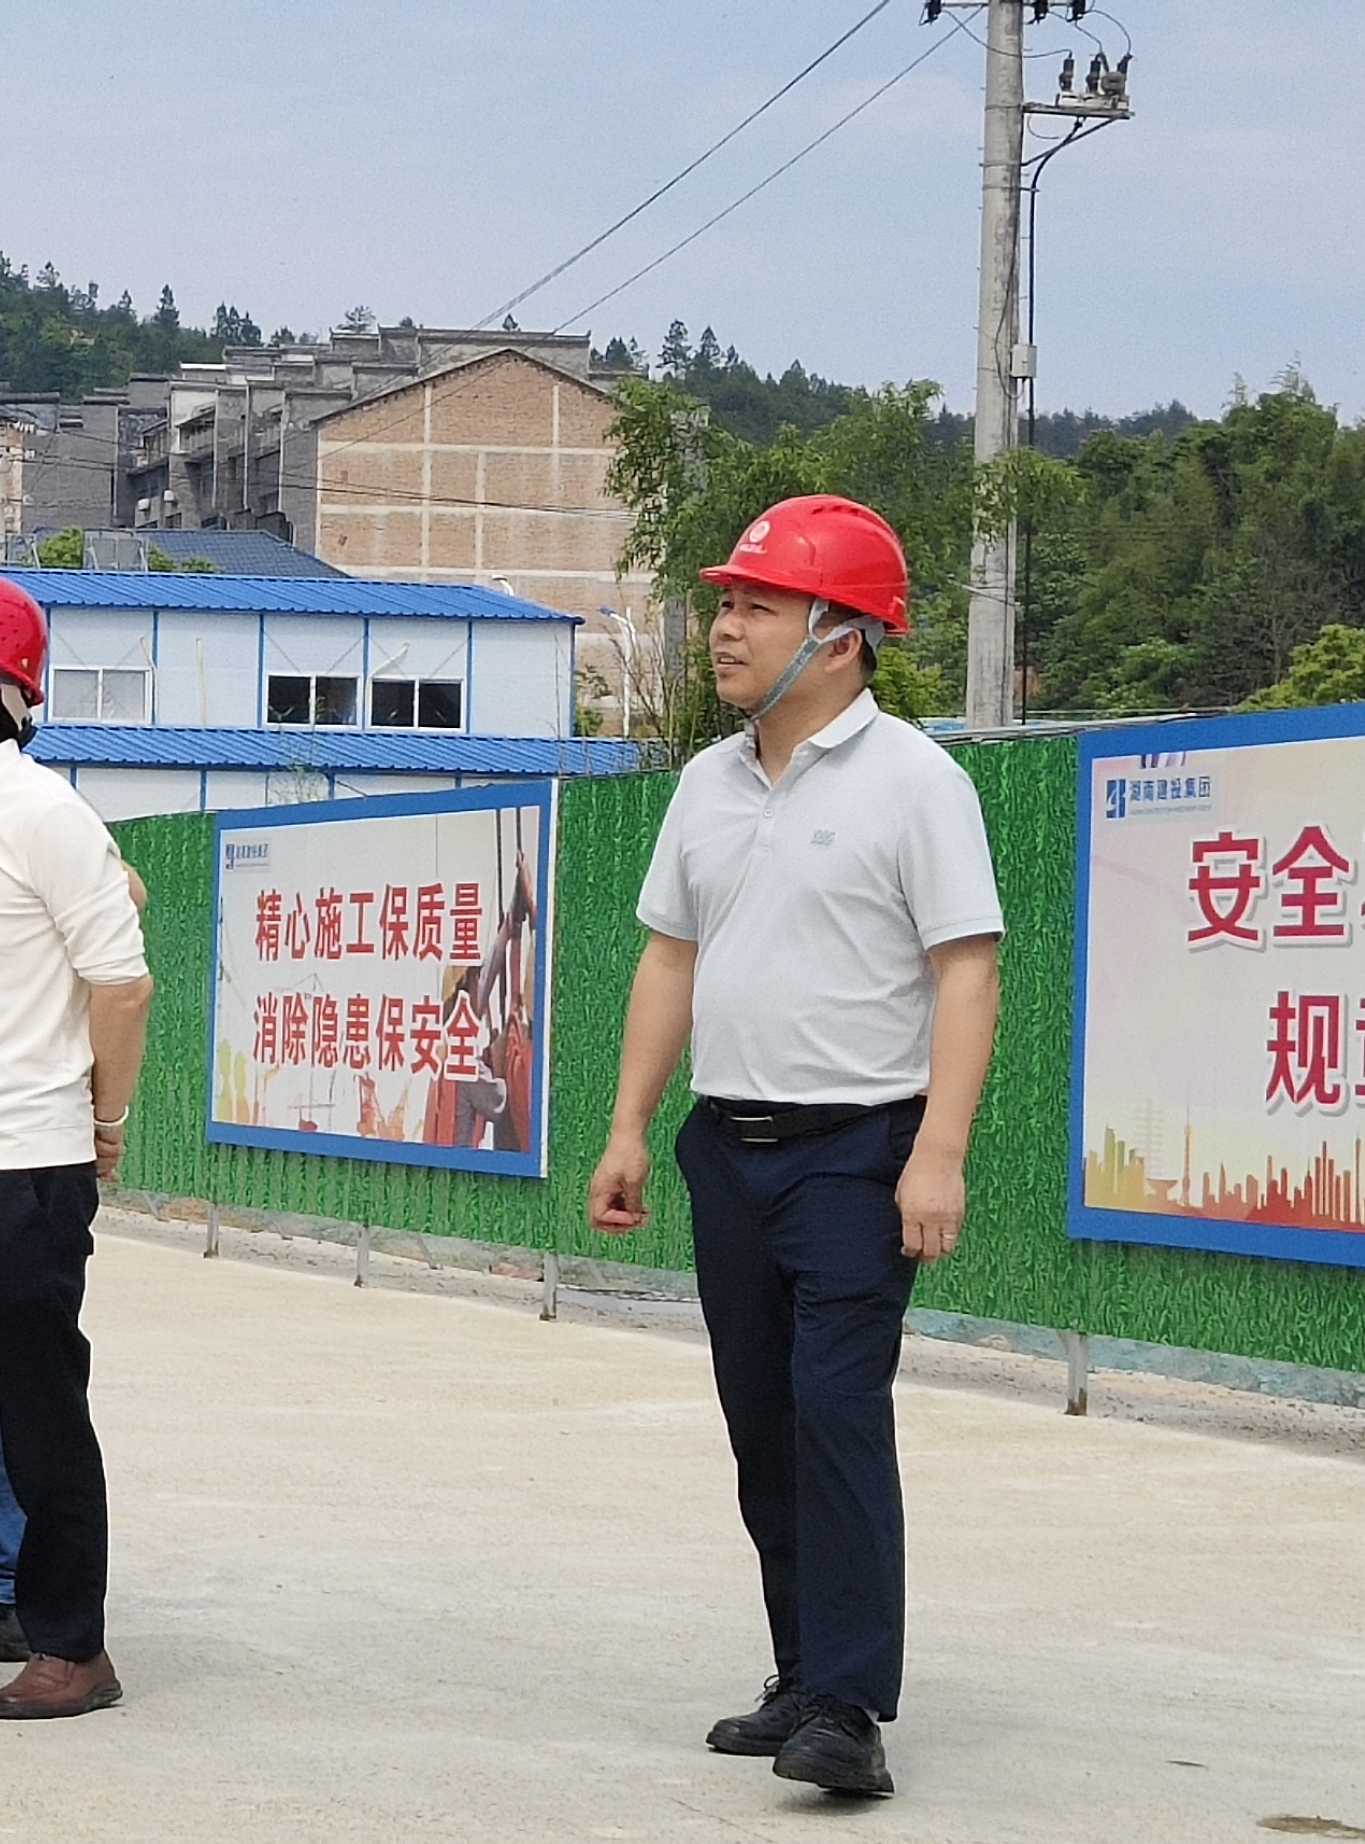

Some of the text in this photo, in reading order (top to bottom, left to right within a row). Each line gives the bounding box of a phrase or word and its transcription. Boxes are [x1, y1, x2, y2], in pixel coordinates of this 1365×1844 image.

[1130, 776, 1211, 802] 湖南建投集团
[255, 882, 483, 962] 精心施工保质量
[1187, 825, 1365, 942] 安全
[253, 991, 481, 1076] 消除隐患保安全
[1265, 990, 1365, 1105] 规
